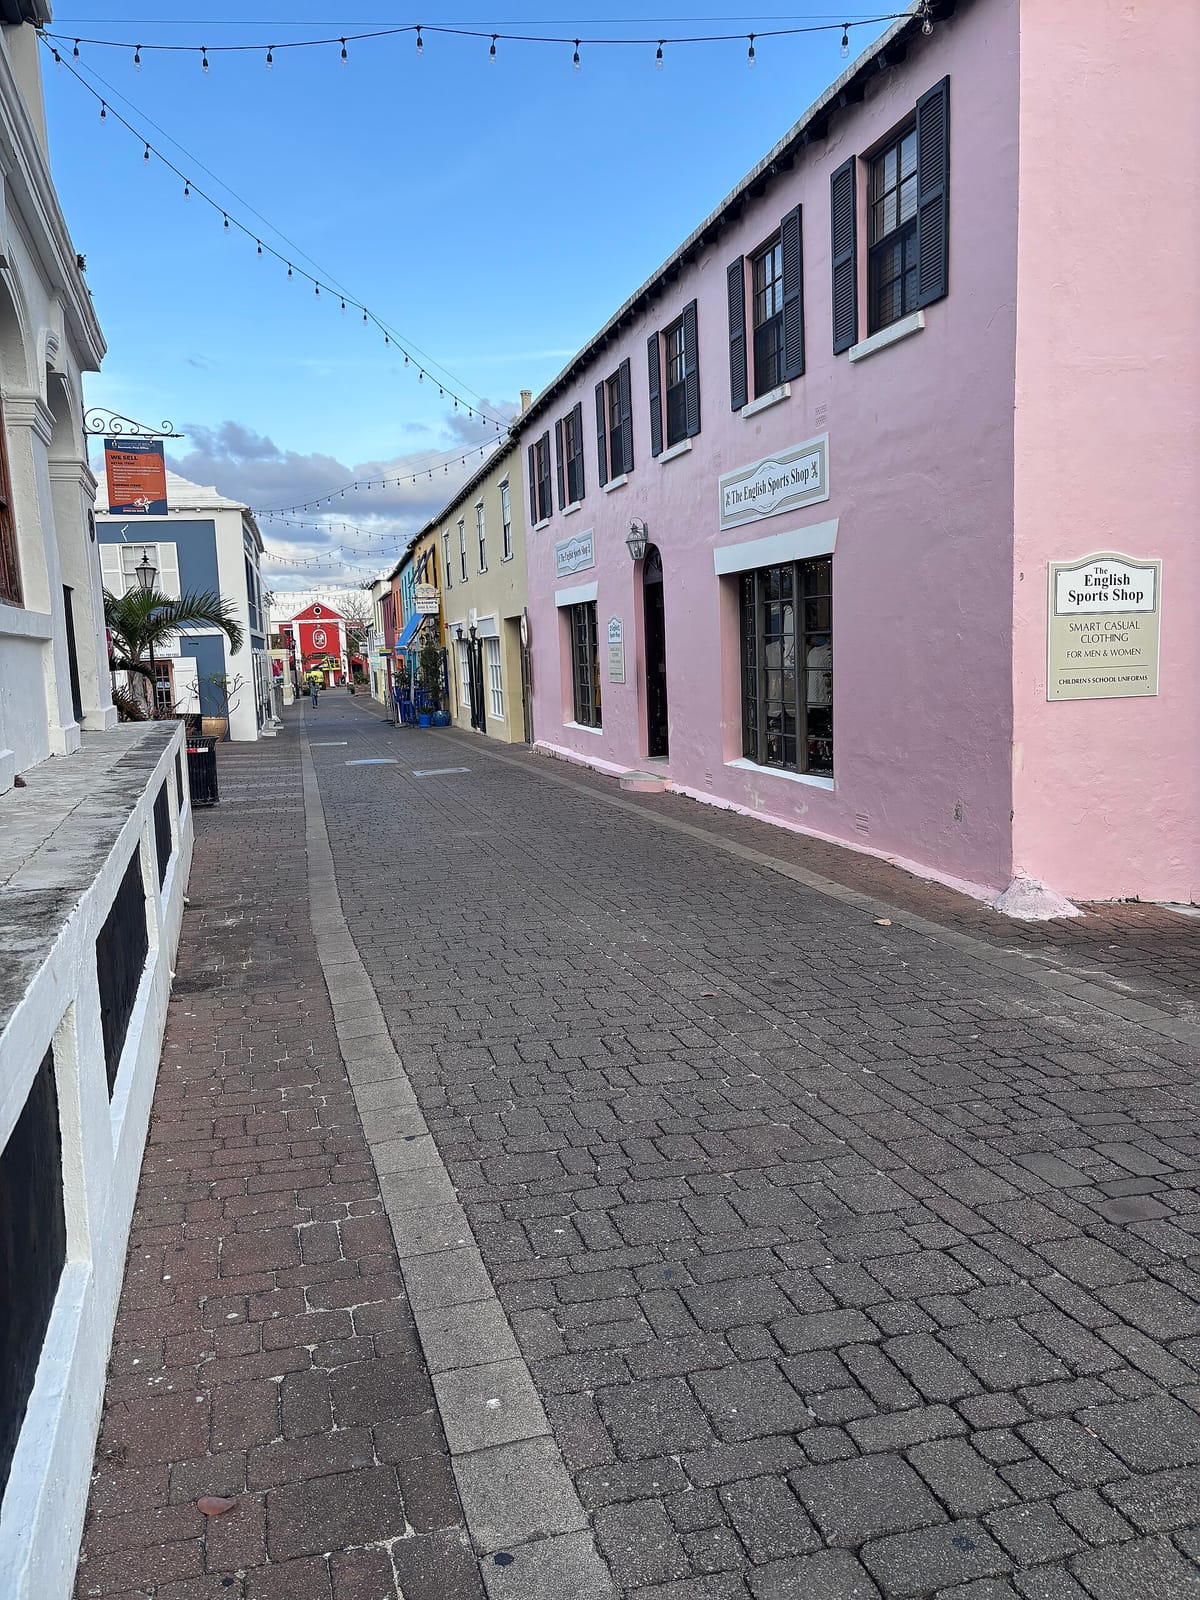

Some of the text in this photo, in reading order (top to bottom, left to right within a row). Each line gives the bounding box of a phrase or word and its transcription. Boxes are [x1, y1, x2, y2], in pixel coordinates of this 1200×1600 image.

[731, 467, 809, 504] The English Sports Shop
[1094, 567, 1108, 575] The
[1084, 573, 1130, 589] English
[1068, 588, 1144, 605] Sports Shop
[1069, 621, 1141, 632] SMART CASUAL
[1080, 633, 1129, 643] CLOTHING
[1066, 648, 1141, 658] FOR MEN & WOMEN
[1059, 677, 1091, 685] CHILDREN'S
[1092, 676, 1117, 684] SCHOOL
